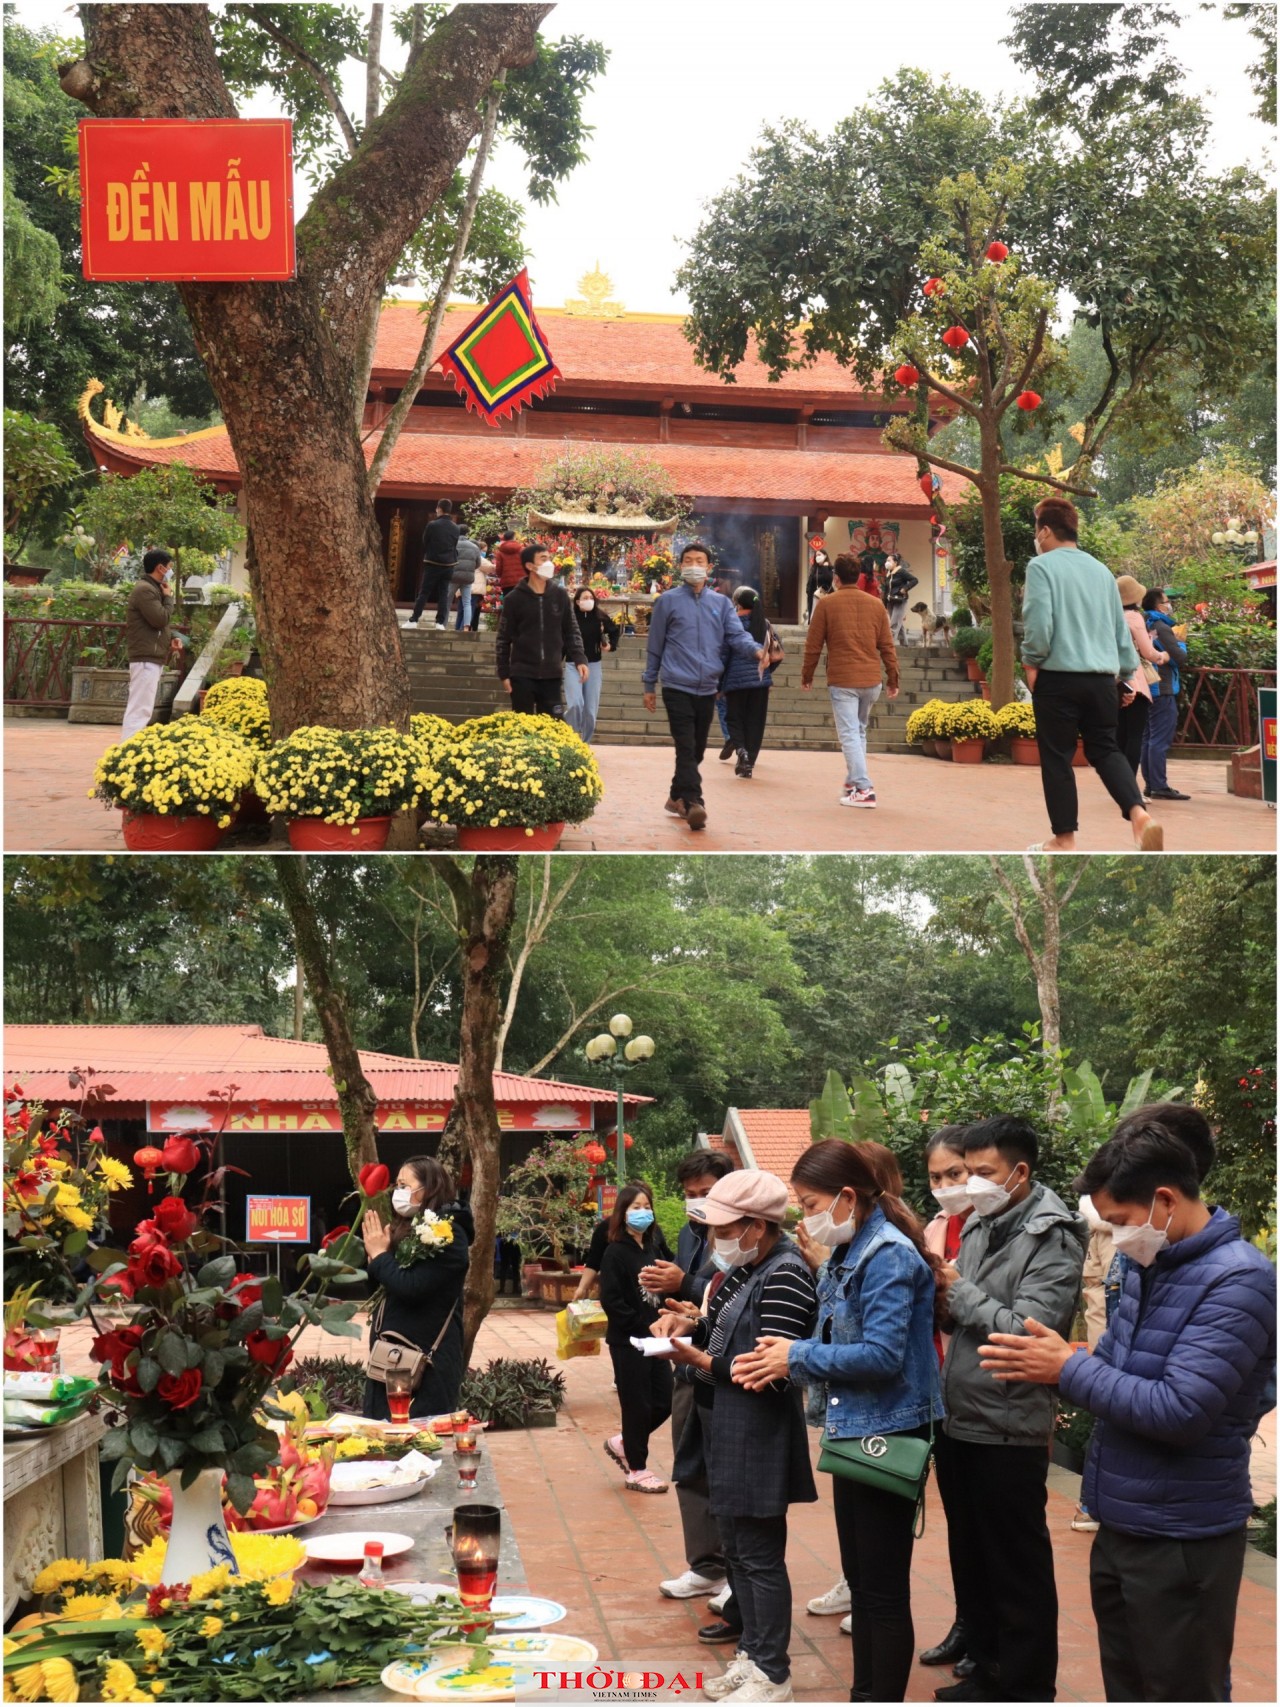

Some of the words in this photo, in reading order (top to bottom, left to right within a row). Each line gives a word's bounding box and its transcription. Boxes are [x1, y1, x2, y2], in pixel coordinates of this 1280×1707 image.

[106, 161, 179, 242] ĐỀN
[188, 157, 271, 241] MẪU
[231, 1112, 332, 1130] NHÀ
[374, 1109, 446, 1129] ẮP
[270, 1202, 290, 1227] HÓA
